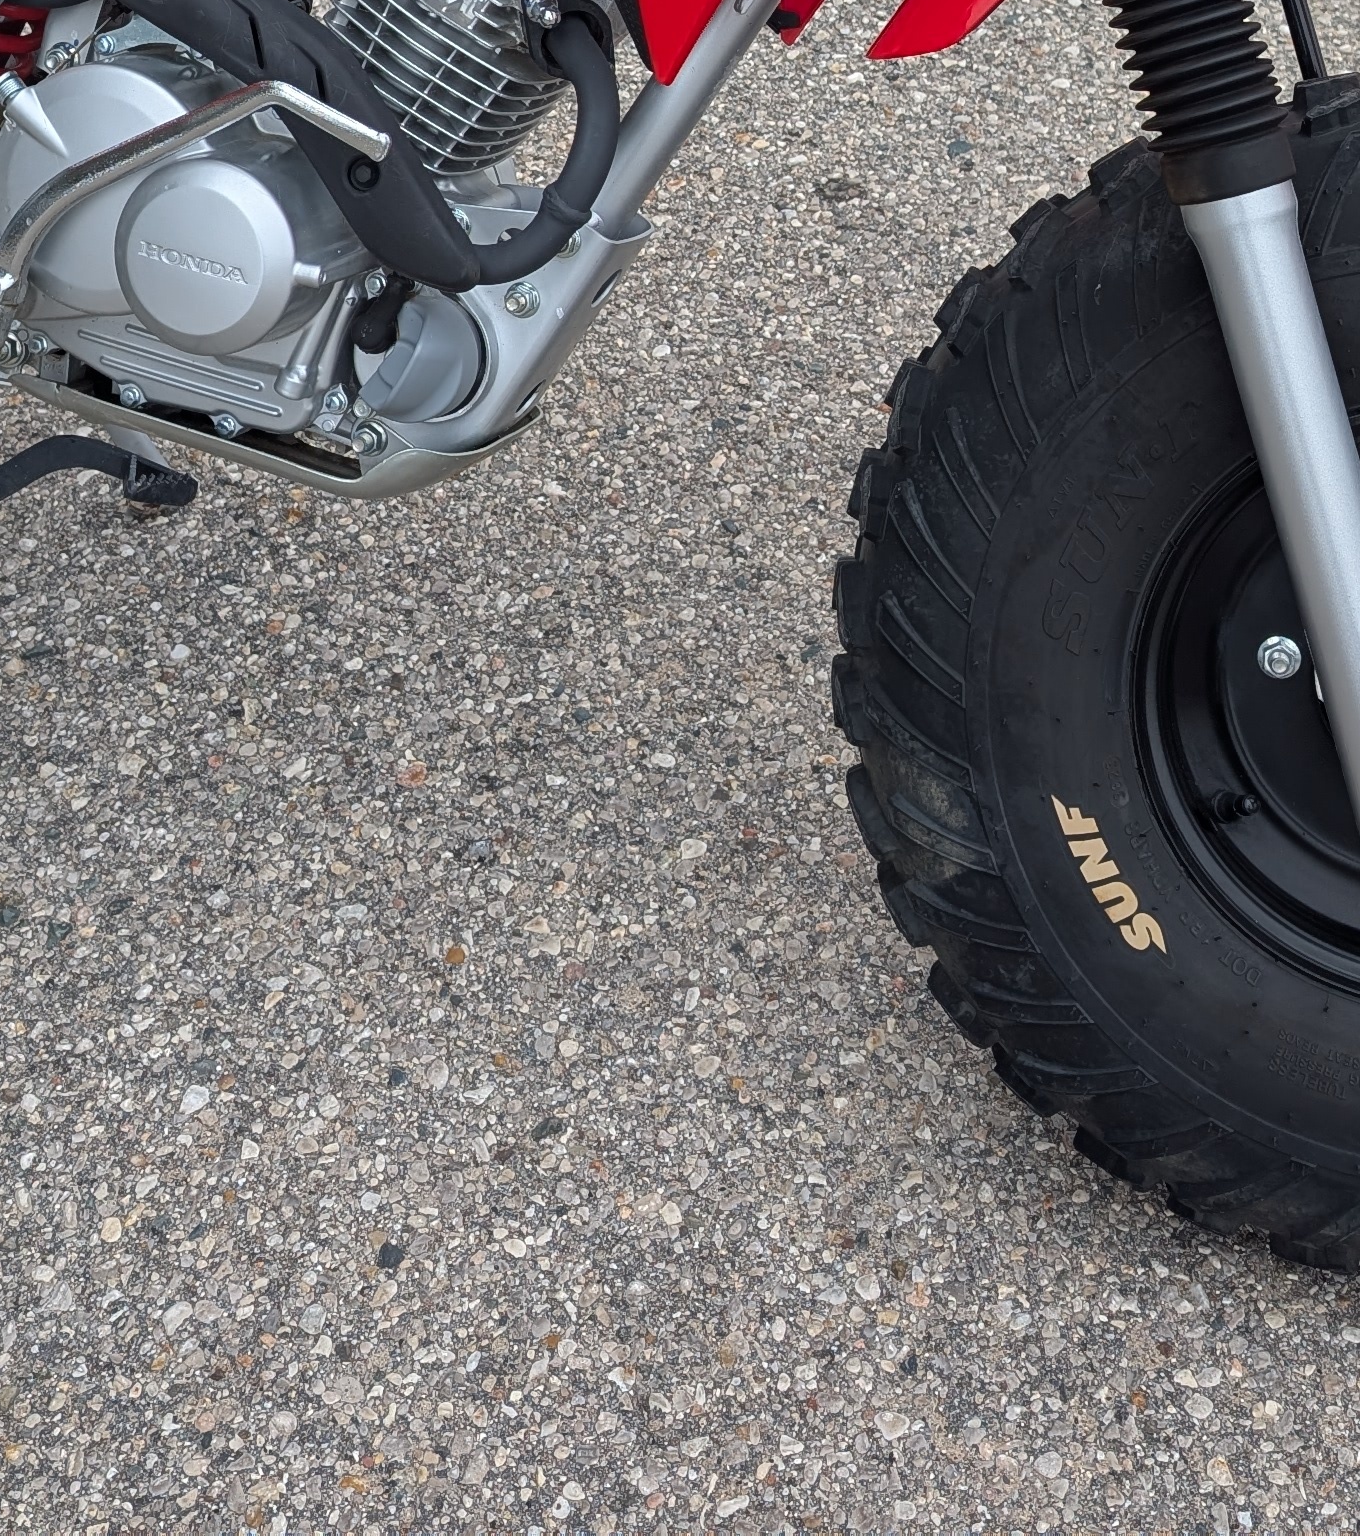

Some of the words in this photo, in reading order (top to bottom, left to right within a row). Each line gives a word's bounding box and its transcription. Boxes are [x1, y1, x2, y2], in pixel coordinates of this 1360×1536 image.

[137, 239, 249, 287] HONDA
[1049, 792, 1168, 955] SUNF
[1217, 946, 1264, 987] DOT
[1278, 1028, 1319, 1055] BEADS
[1326, 1048, 1360, 1069] SEAT
[1267, 1058, 1347, 1101] TUBELESS
[1275, 1045, 1341, 1080] PRESSURE
